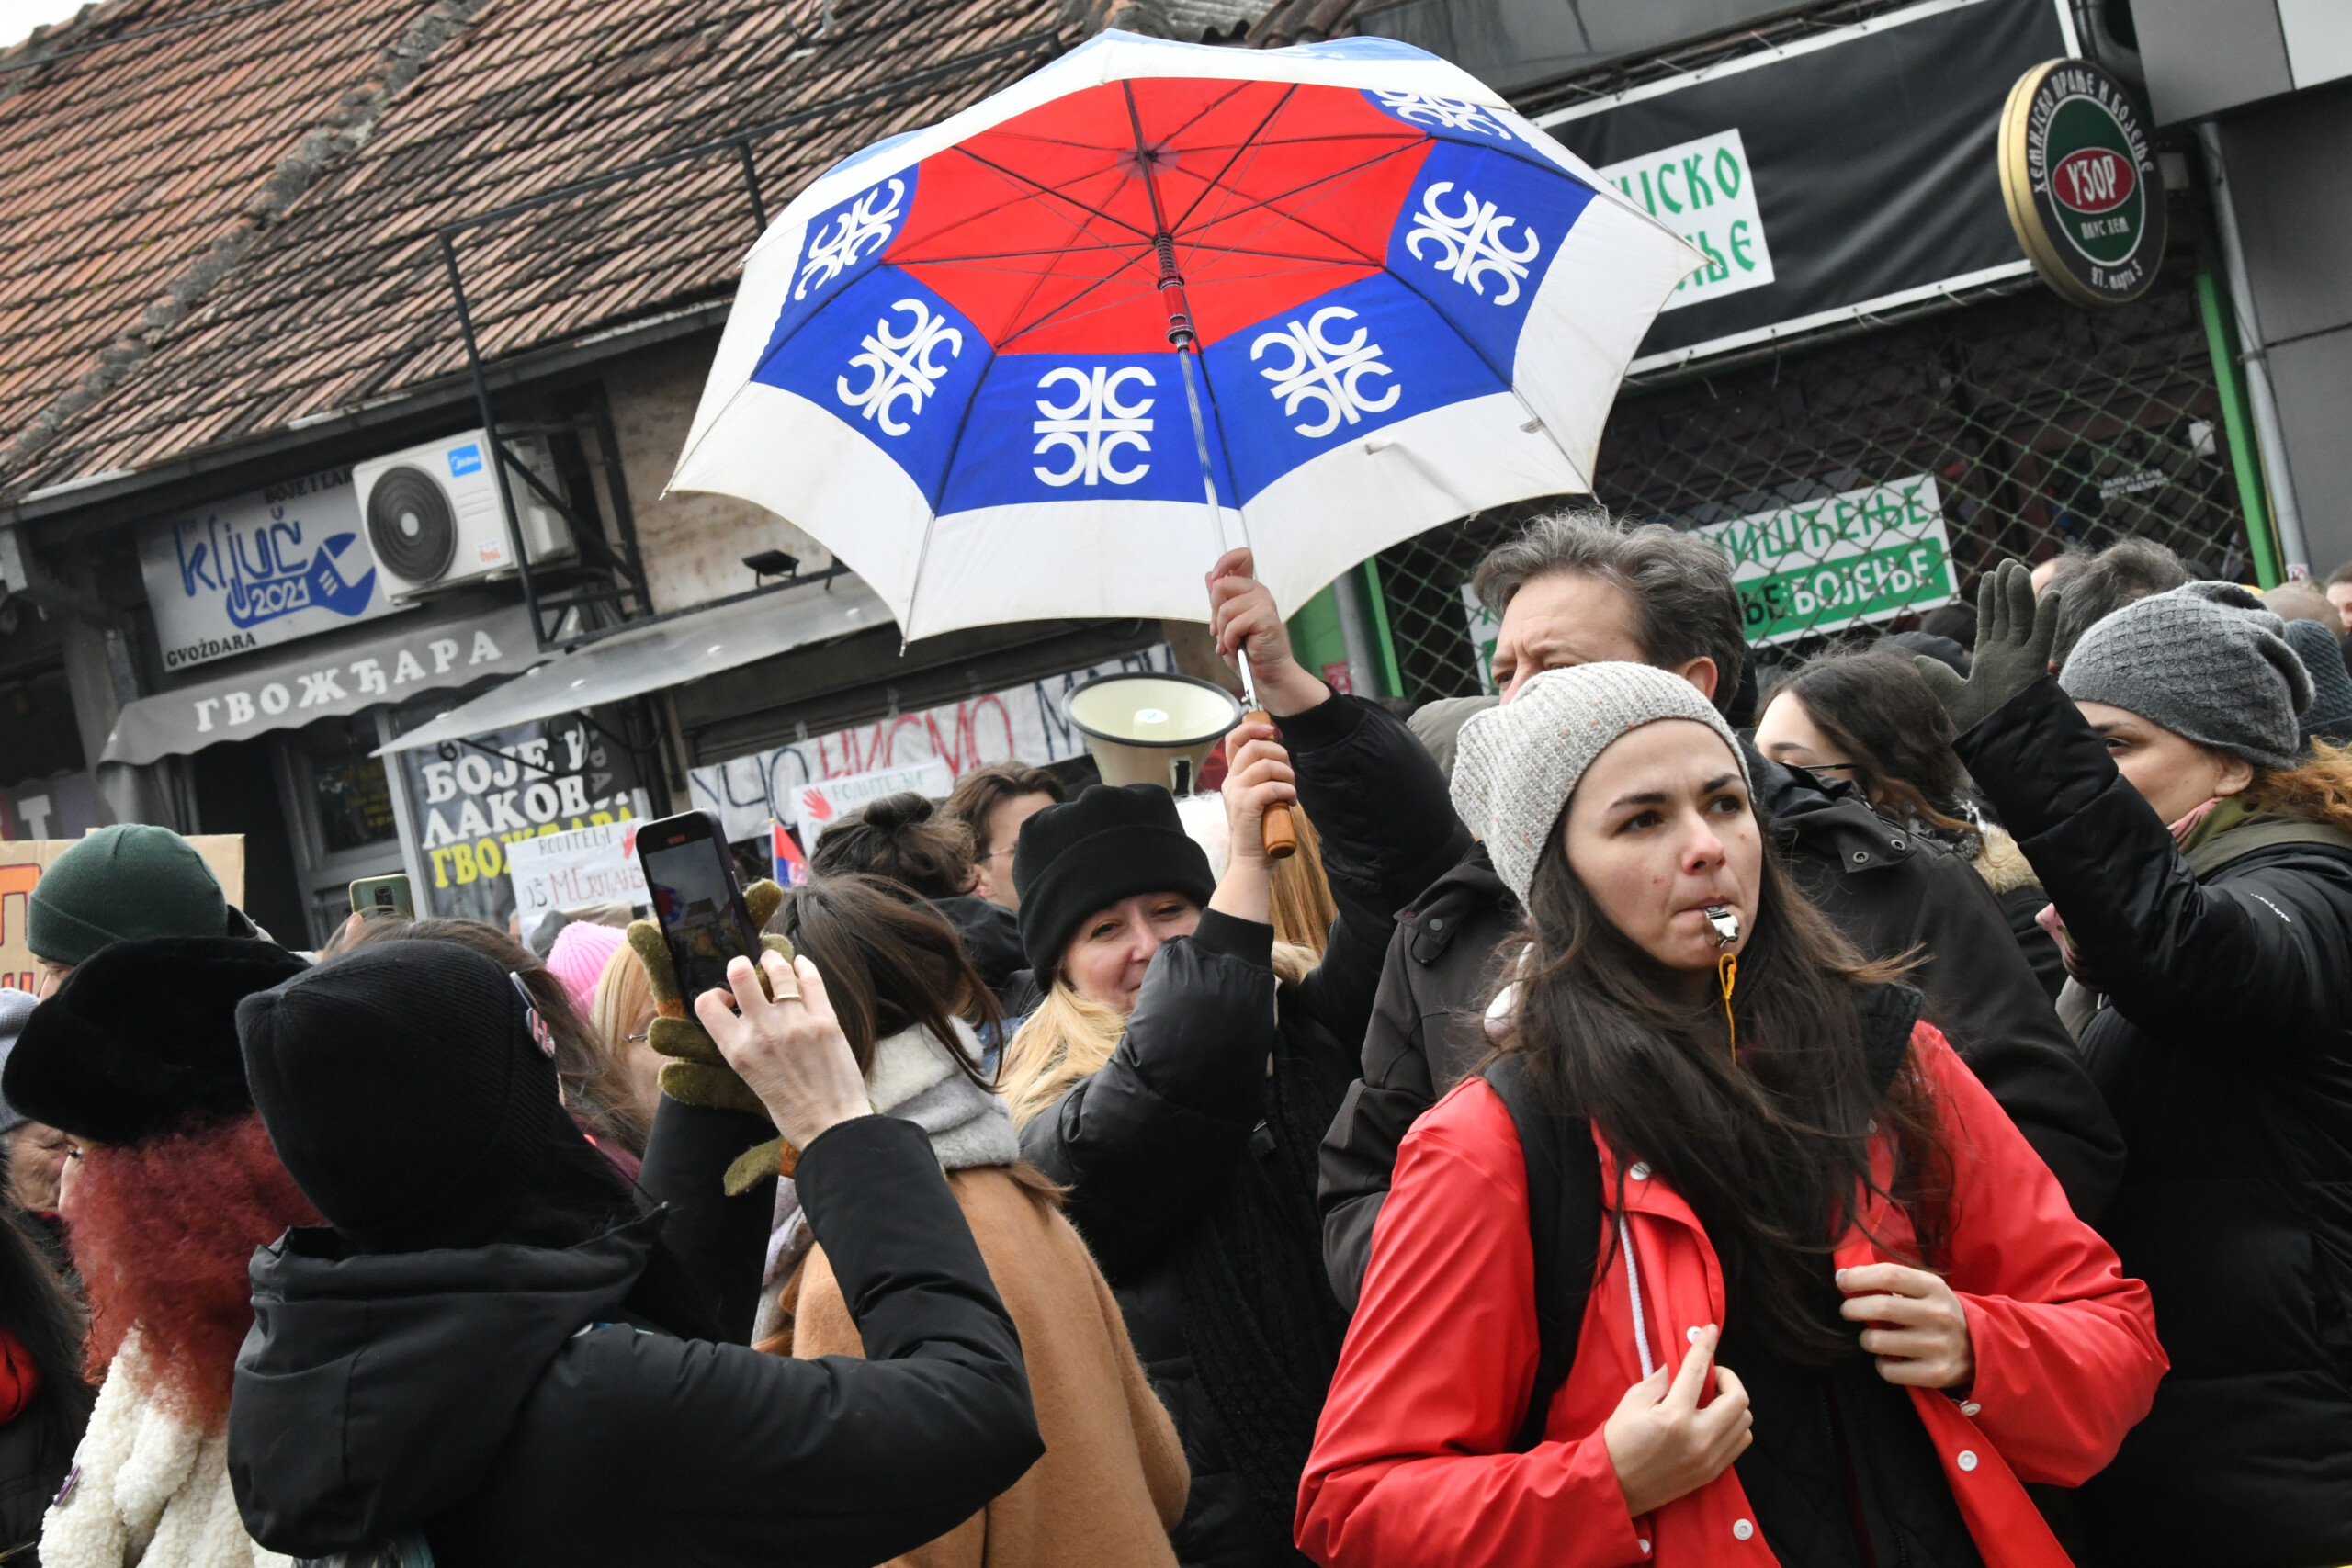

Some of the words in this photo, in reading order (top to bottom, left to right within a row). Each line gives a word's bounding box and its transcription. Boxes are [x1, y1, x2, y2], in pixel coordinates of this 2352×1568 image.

[1611, 147, 1741, 217] ЈСКО
[2066, 155, 2116, 206] УЗОР
[1676, 220, 1757, 291] ЊЕ
[1716, 484, 1929, 565] ИШЋЕЊЕ
[250, 576, 311, 618] 2021
[1792, 548, 1934, 616] БОЈЕЊЕ
[194, 630, 503, 733] ГВОЖЂАРА
[423, 738, 555, 805] БОЈЕ
[422, 774, 629, 850] ЛАКОВ
